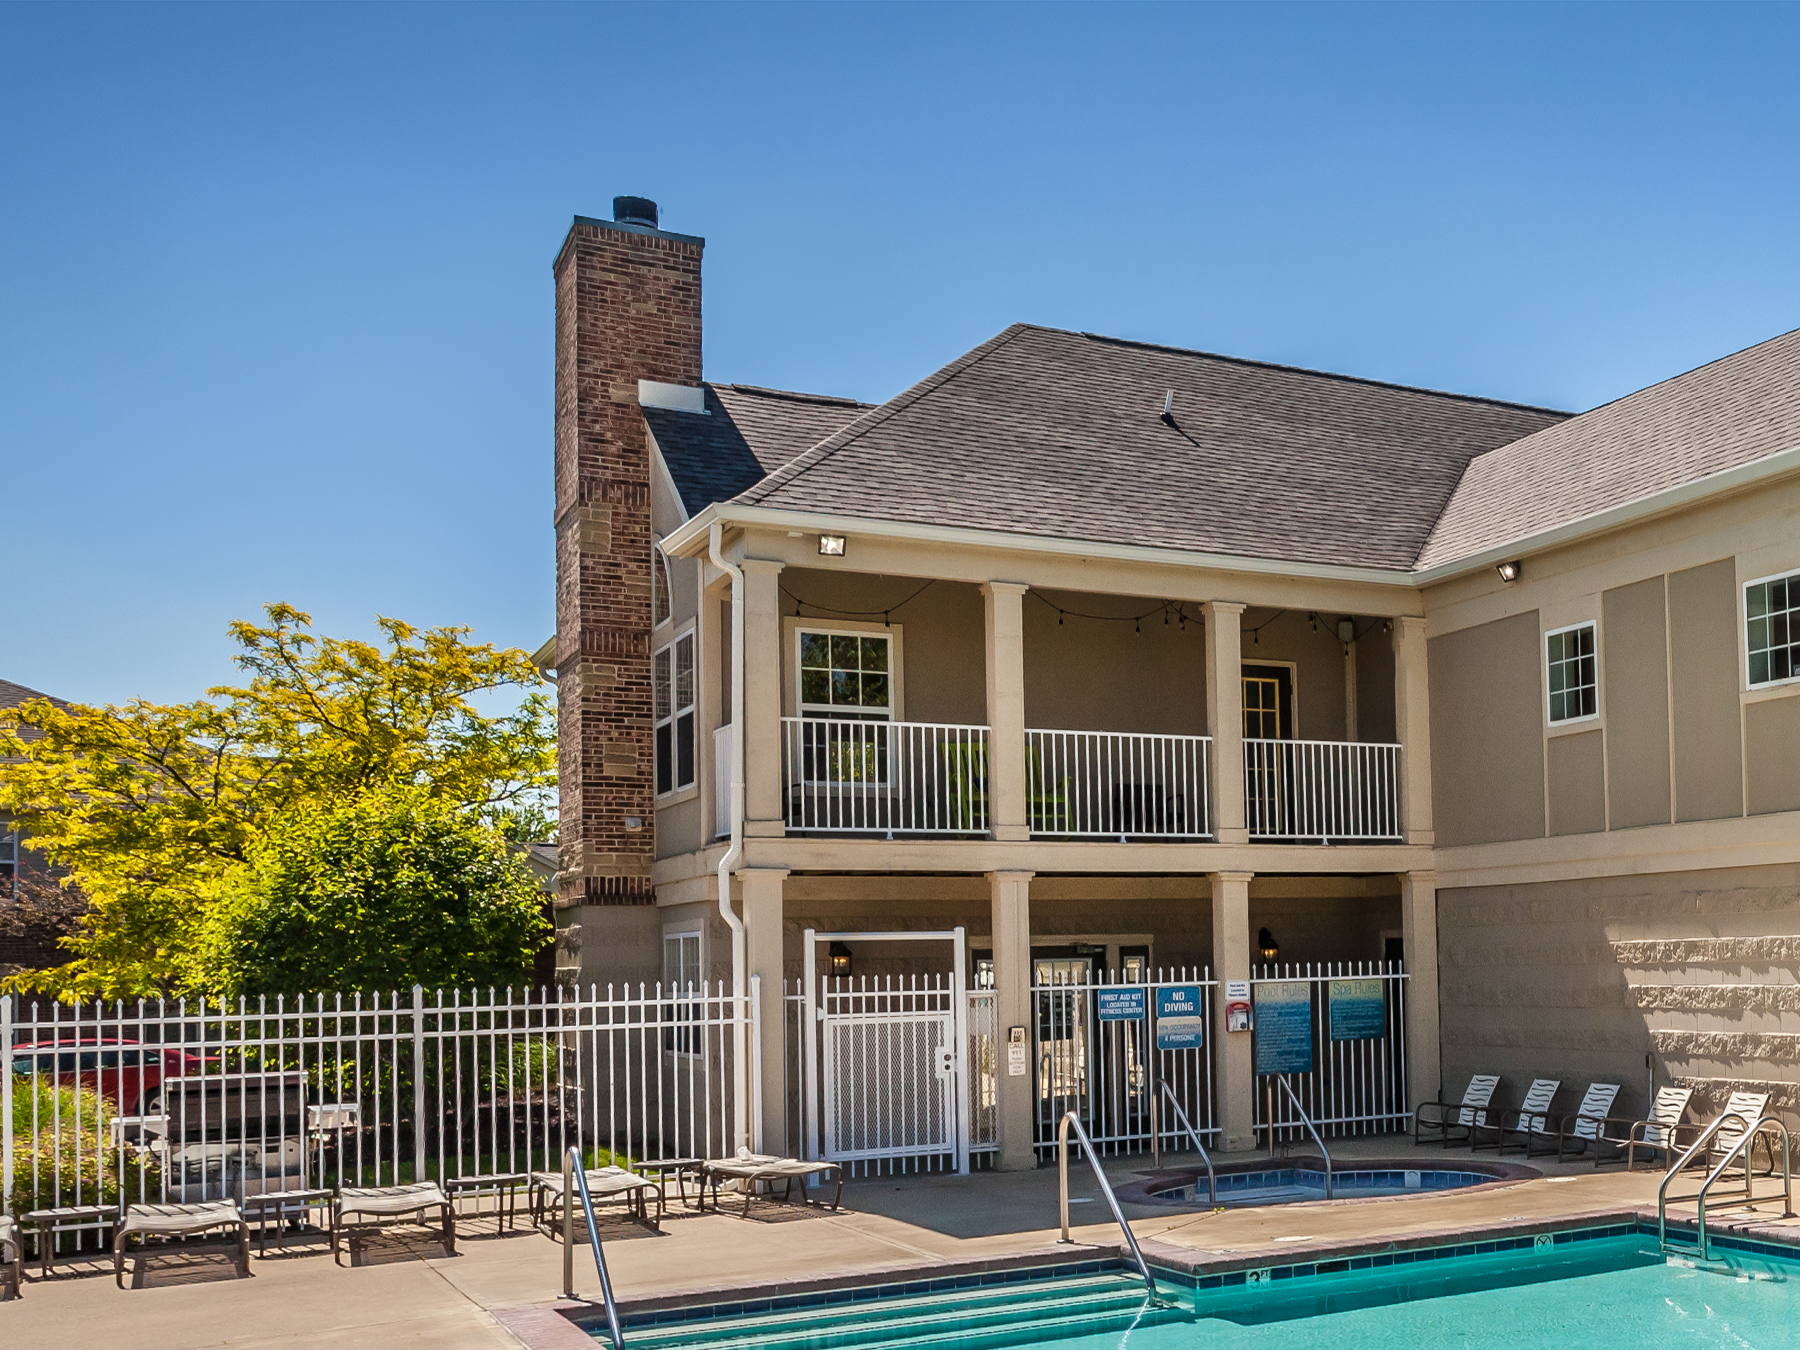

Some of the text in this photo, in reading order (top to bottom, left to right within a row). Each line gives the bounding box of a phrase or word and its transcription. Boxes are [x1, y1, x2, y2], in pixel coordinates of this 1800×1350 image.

[1257, 984, 1279, 997] Pool
[1282, 983, 1308, 996] Rules
[1333, 981, 1380, 997] Spa Rules
[1172, 991, 1185, 1001] NO
[1164, 1002, 1194, 1013] DIVING
